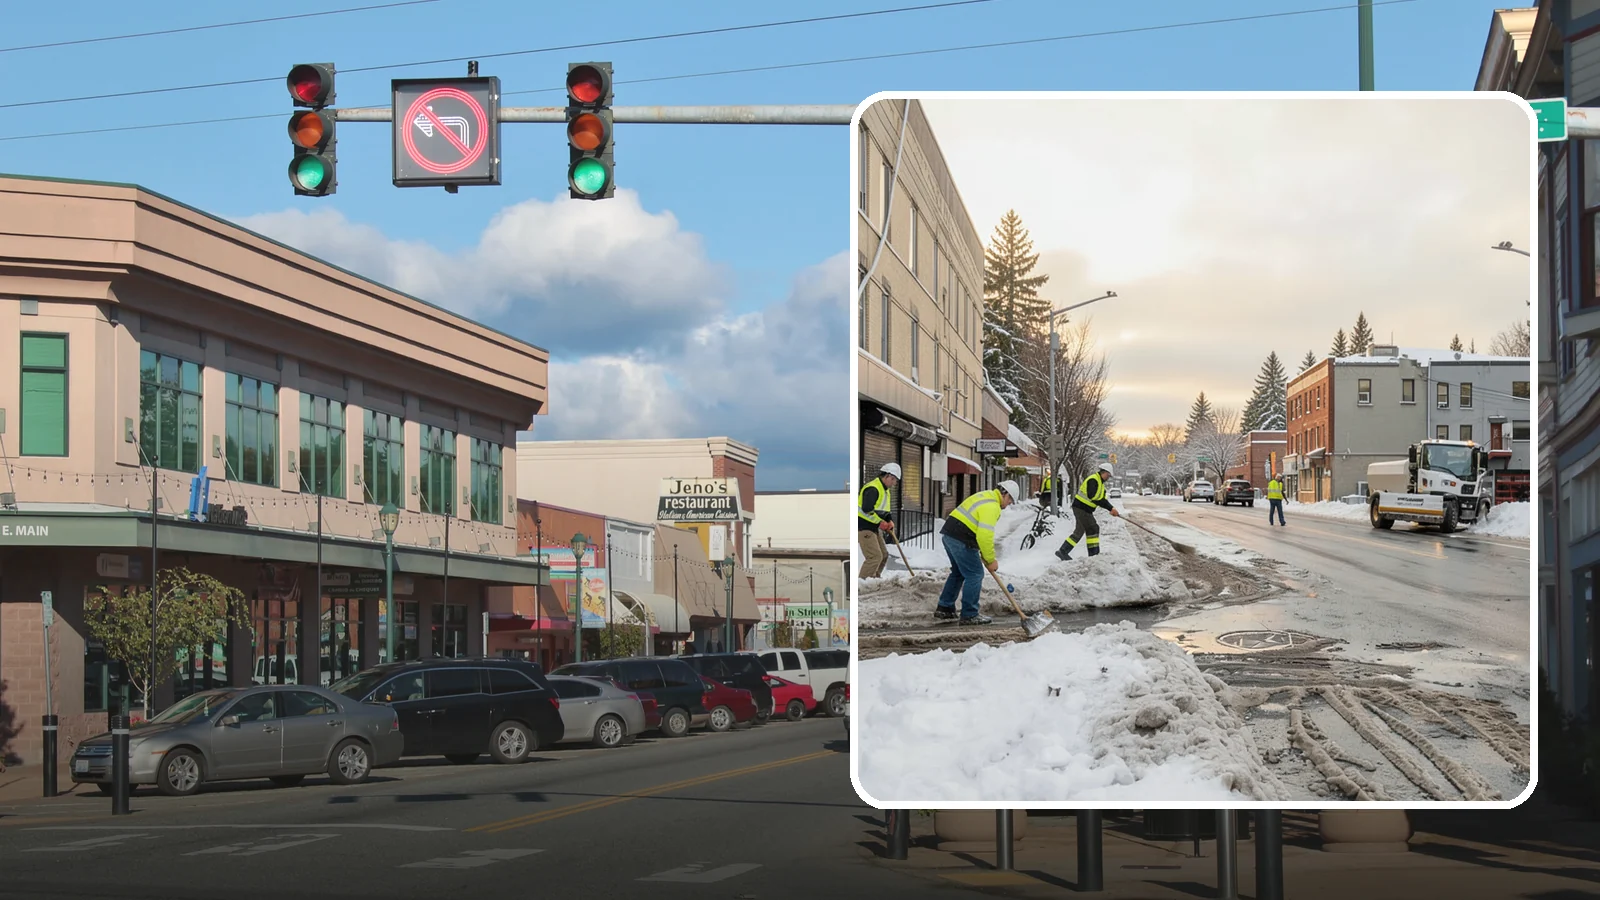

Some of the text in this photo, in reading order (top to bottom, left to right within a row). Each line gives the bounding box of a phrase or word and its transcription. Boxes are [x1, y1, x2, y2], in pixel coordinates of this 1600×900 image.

[669, 480, 728, 495] Jeno's
[665, 496, 731, 509] restaurant
[658, 510, 682, 519] Italian
[685, 509, 715, 519] American
[715, 509, 737, 519] Cuisine
[2, 525, 49, 536] E. MAIN
[797, 607, 828, 617] Street
[790, 619, 823, 627] lass
